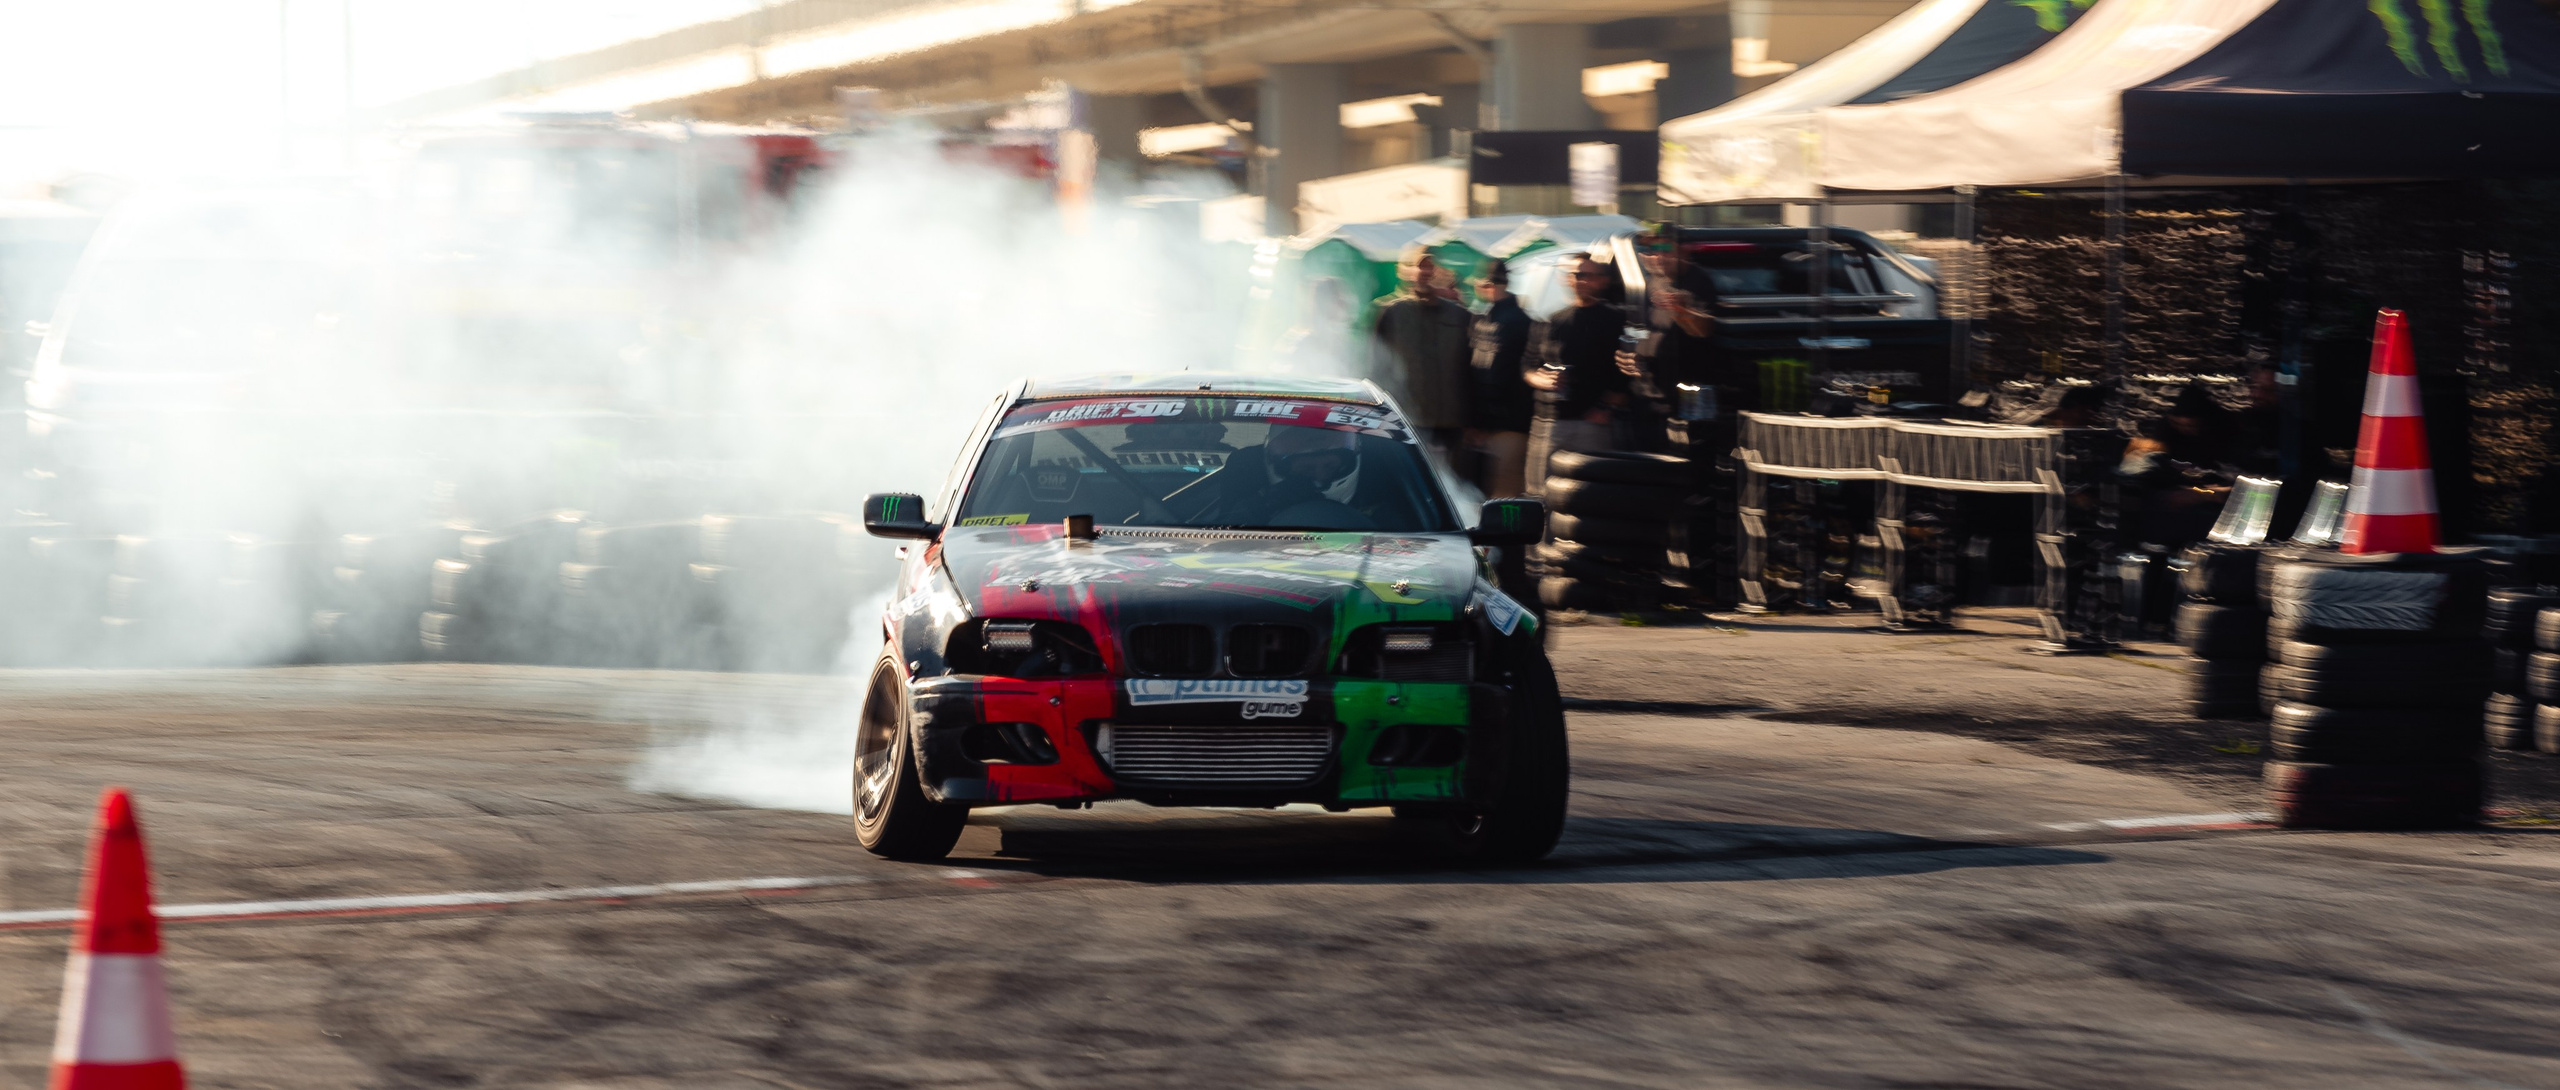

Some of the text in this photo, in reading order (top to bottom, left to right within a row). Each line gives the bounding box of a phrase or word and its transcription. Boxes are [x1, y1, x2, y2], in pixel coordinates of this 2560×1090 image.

[1048, 406, 1121, 420] DRIFT
[1121, 402, 1187, 418] SDC
[1245, 702, 1300, 717] gume
